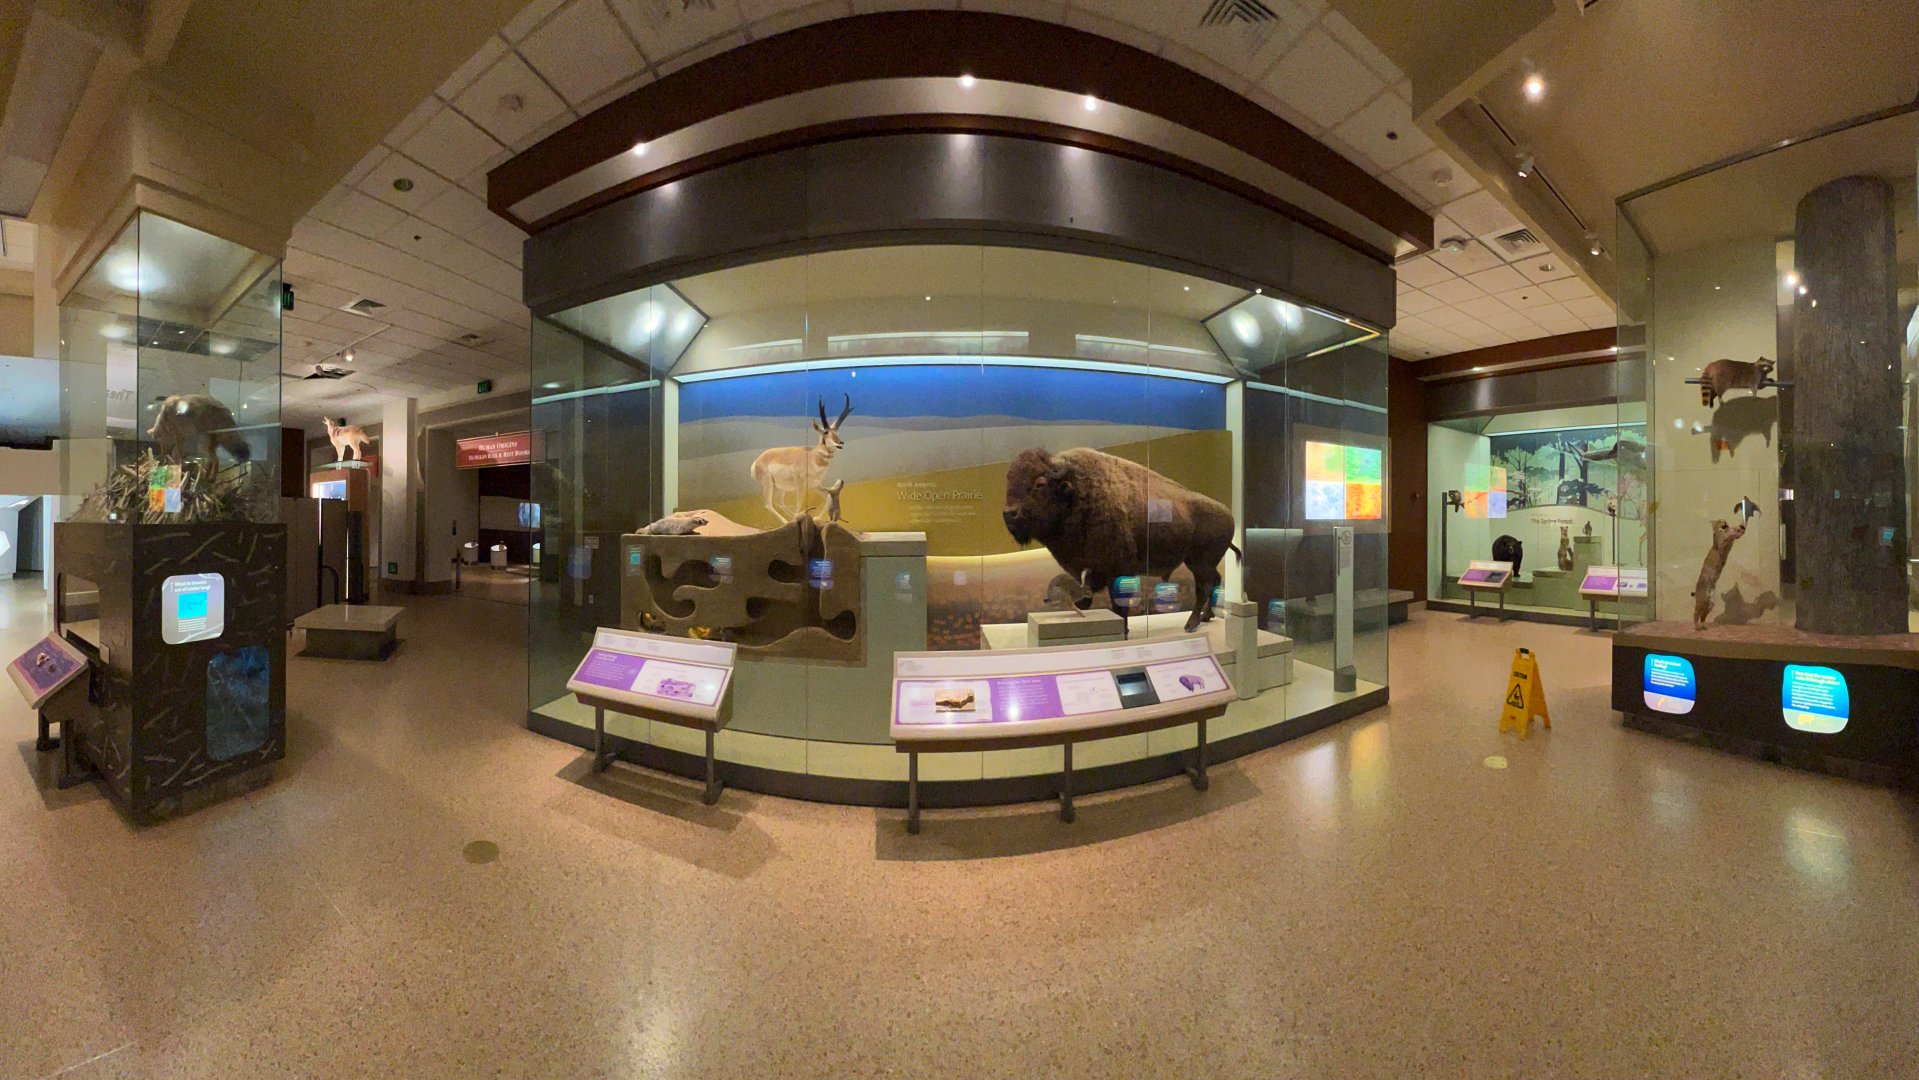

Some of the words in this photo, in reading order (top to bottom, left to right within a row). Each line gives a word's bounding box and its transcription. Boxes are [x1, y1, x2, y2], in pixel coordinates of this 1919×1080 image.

[896, 490, 922, 501] Wide
[924, 490, 950, 502] Open
[952, 489, 983, 501] Prairie
